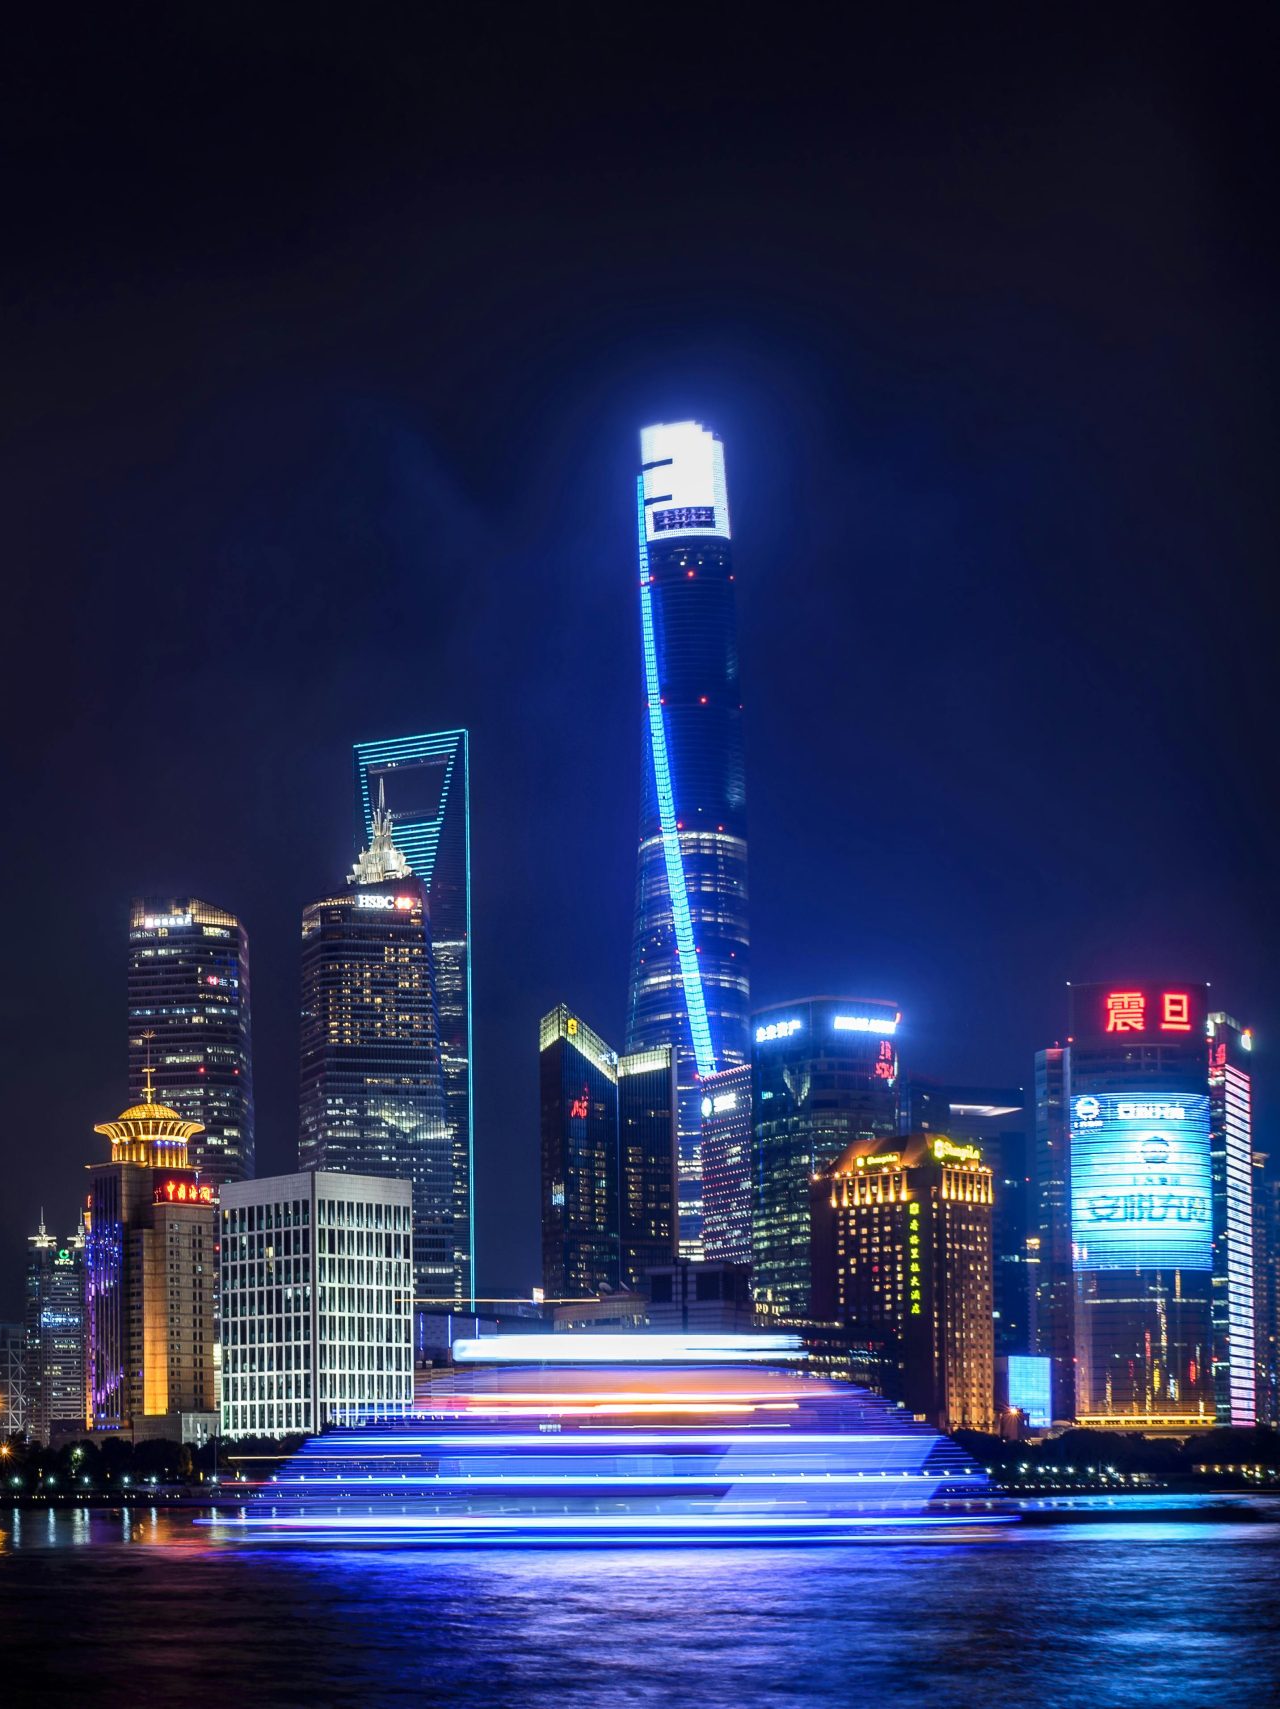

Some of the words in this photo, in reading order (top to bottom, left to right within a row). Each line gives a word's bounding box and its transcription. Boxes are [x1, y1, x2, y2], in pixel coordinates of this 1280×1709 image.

[358, 895, 394, 909] HSBC
[1106, 992, 1191, 1032] 震旦
[167, 1181, 210, 1201] 中国海关
